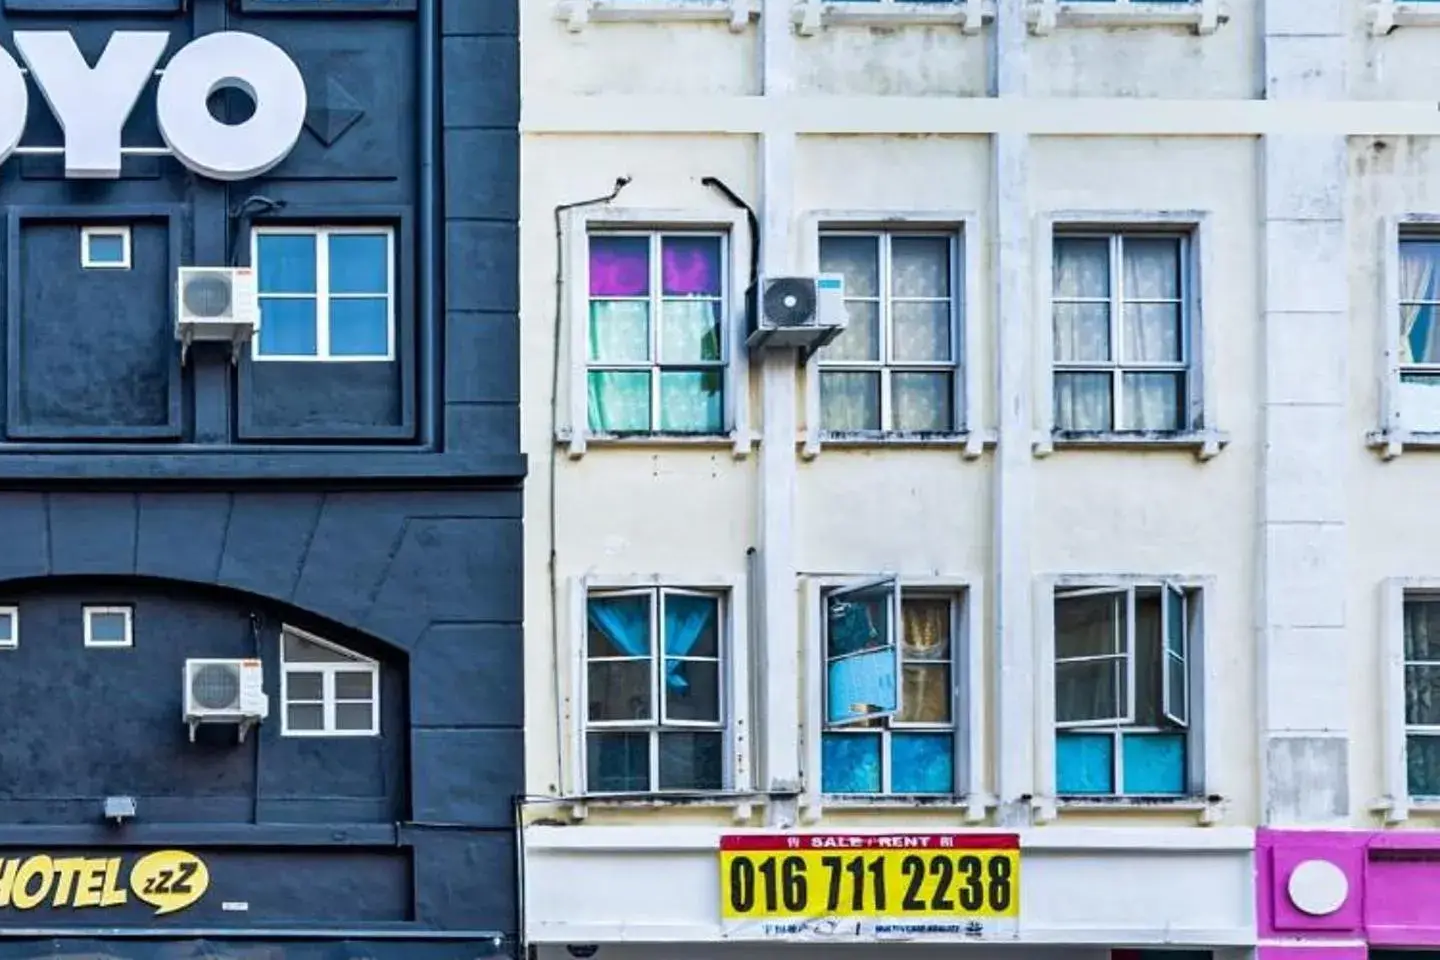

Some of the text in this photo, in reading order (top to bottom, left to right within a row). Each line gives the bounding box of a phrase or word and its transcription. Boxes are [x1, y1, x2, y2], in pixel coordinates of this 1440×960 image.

[810, 836, 864, 848] SALE
[877, 836, 931, 848] RENT
[730, 855, 1011, 912] 016 711 2238
